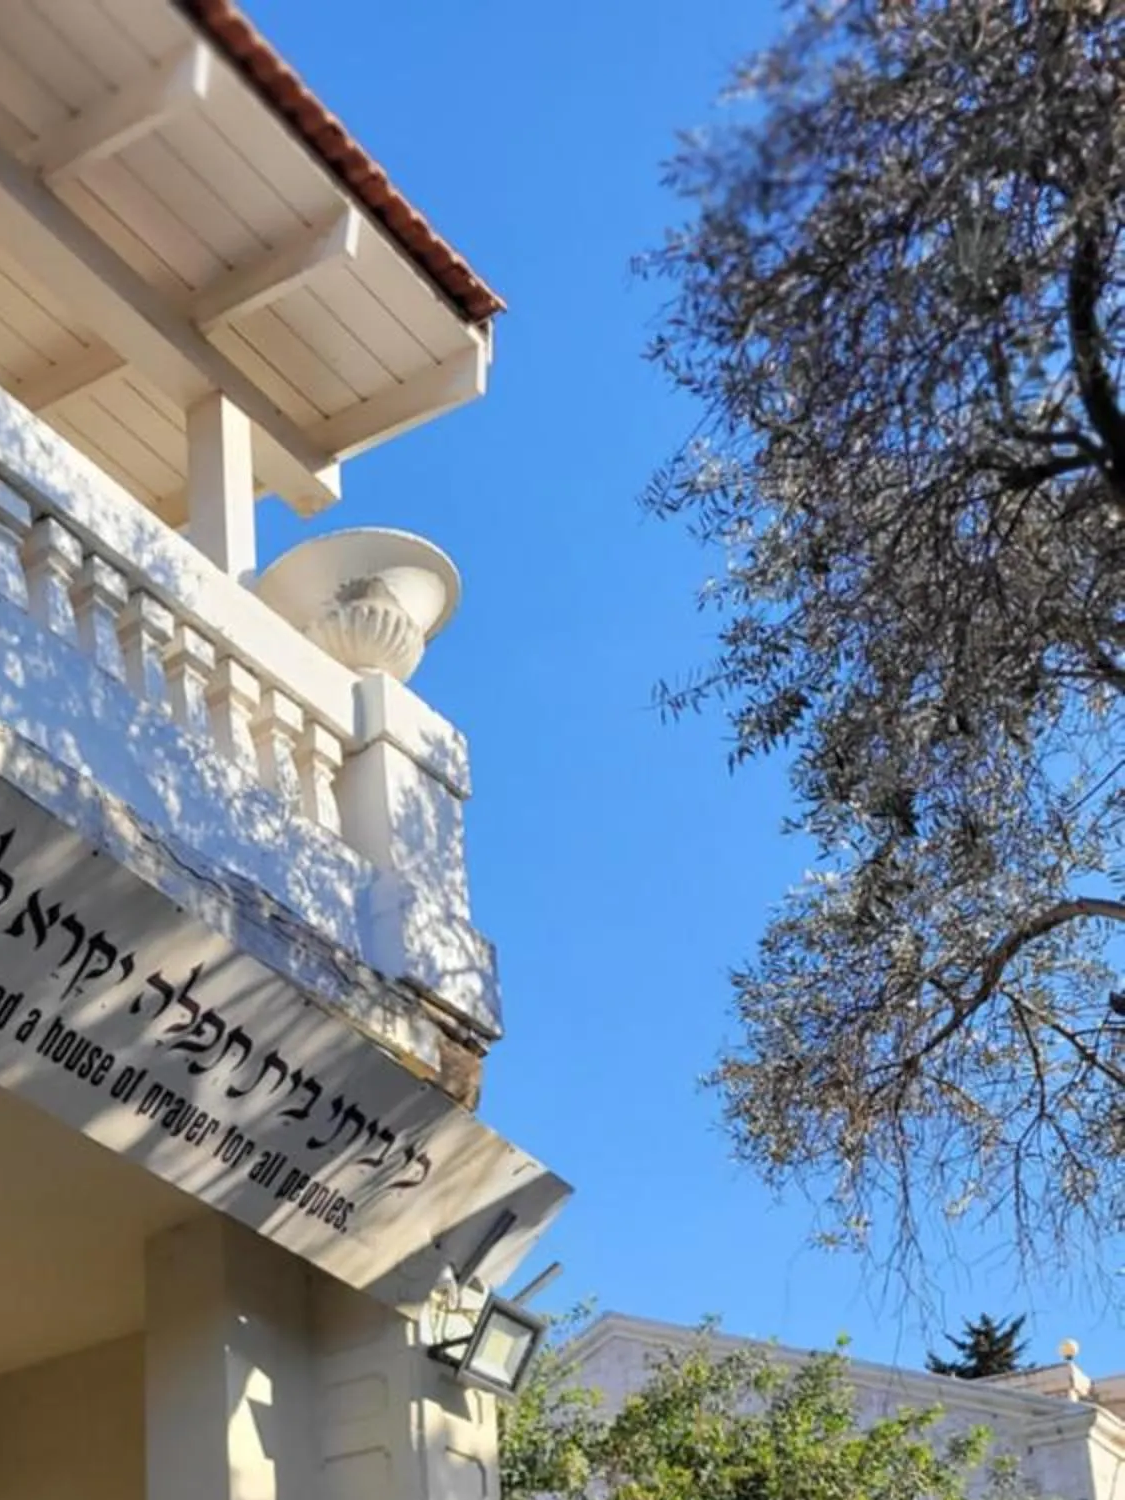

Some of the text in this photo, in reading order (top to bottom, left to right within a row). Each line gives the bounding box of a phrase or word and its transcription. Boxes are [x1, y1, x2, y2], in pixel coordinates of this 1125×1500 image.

[15, 1007, 43, 1043] a
[37, 1016, 116, 1088] house
[109, 1064, 138, 1104] of
[134, 1081, 221, 1148] prayer
[213, 1124, 257, 1170] for
[248, 1149, 289, 1189] all
[280, 1167, 356, 1235] peoples.
